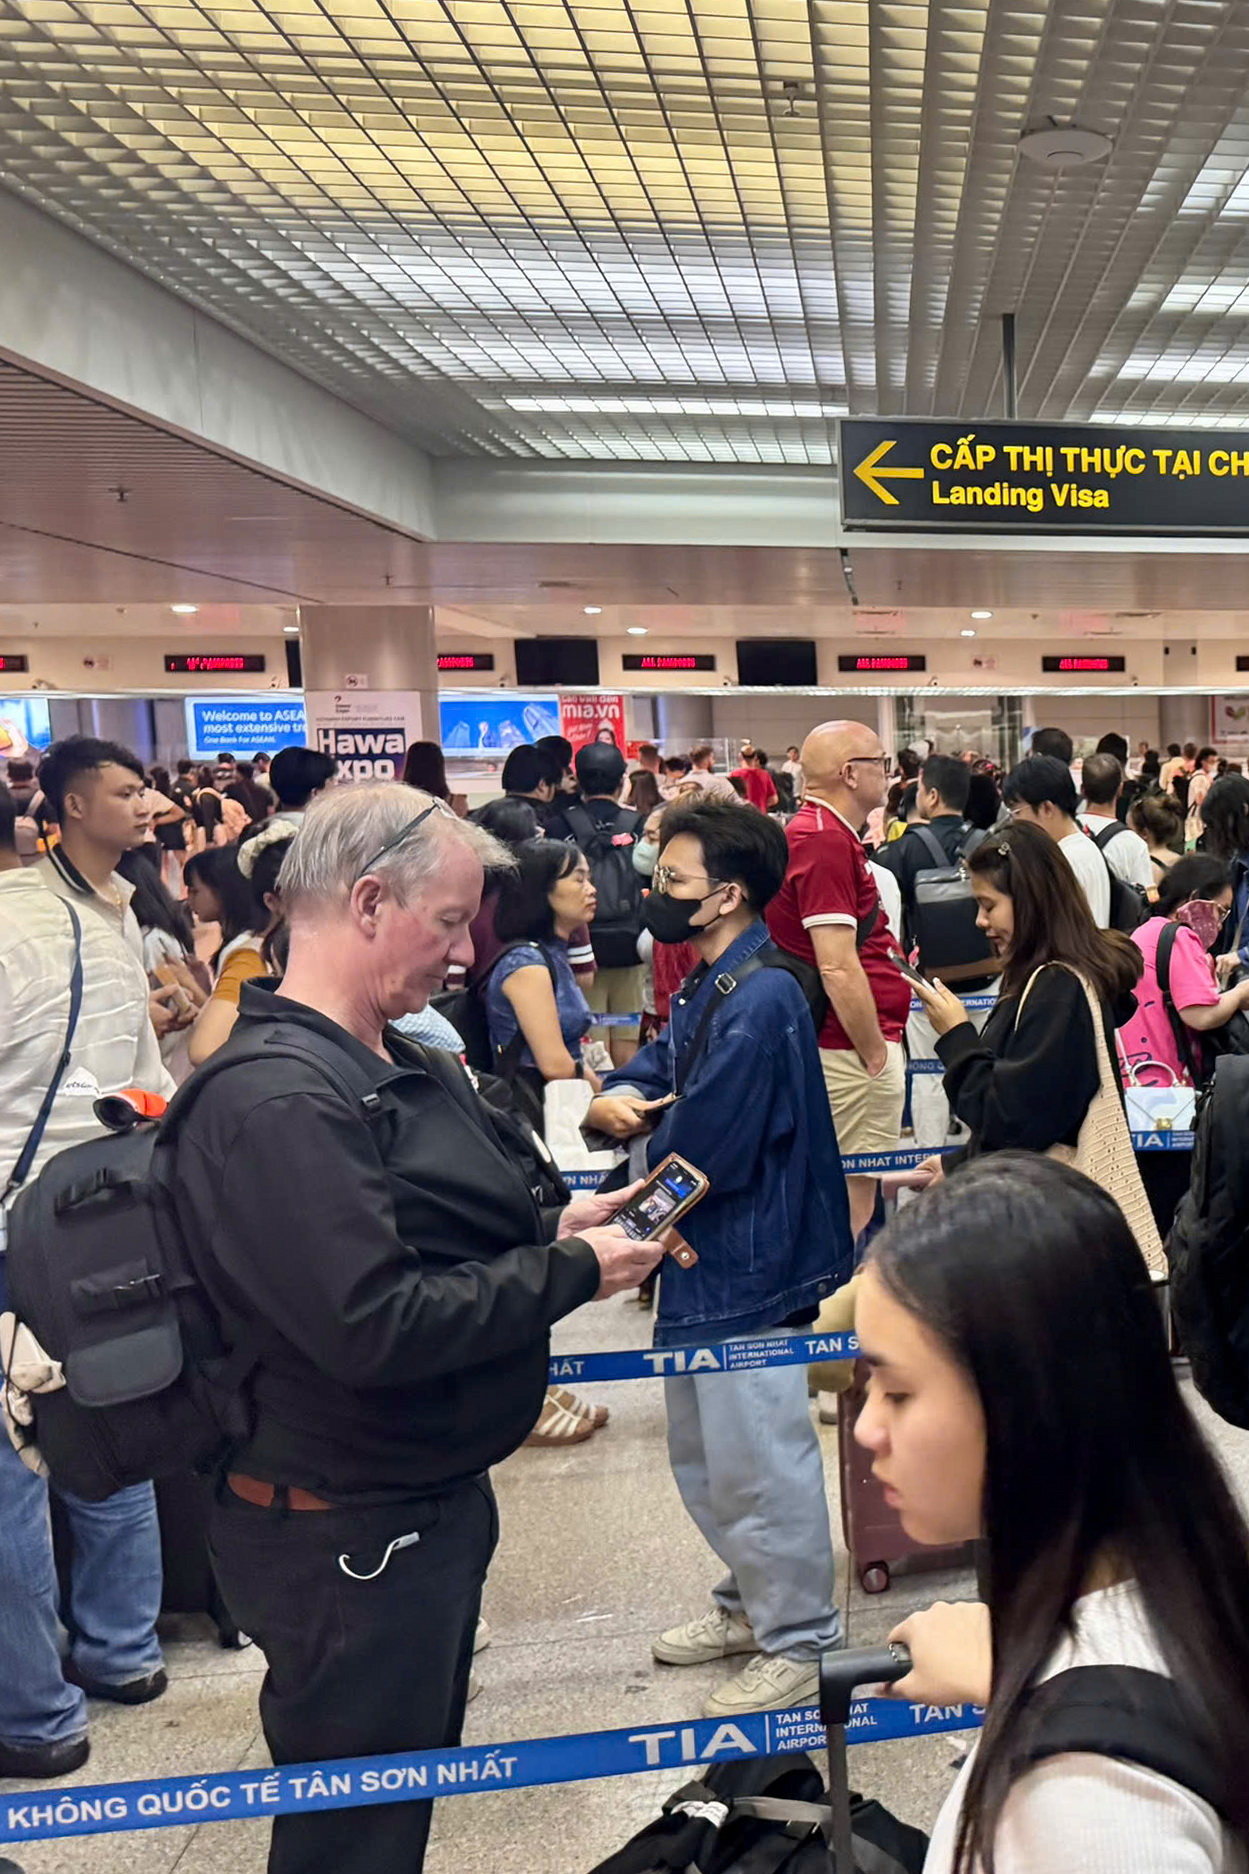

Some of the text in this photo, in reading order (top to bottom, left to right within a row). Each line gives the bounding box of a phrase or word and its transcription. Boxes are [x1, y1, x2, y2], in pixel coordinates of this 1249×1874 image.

[930, 434, 996, 471] CẤP
[1003, 445, 1053, 478] THỊ
[1060, 444, 1146, 478] THỰC
[1153, 449, 1201, 480] TẠI
[932, 480, 1110, 512] Landing Visa
[202, 710, 257, 722] Welcome
[259, 711, 273, 721] to
[562, 704, 620, 719] mia.vn
[203, 722, 234, 734] most
[235, 722, 291, 733] extensive
[318, 729, 405, 755] Hawa
[333, 757, 396, 783] xpo
[728, 1348, 794, 1360] INTERNATIONAL
[805, 1337, 842, 1355] TAN
[643, 1348, 720, 1374] TIA
[730, 1359, 767, 1369] AIRPORT
[775, 1711, 801, 1725] TAN
[804, 1709, 821, 1720] SO
[909, 1703, 963, 1724] TAN
[628, 1723, 758, 1766] TIA
[777, 1735, 827, 1751] AIRPOR
[8, 1749, 519, 1830] KHÔNG QUỐC TẾ TÂN SƠN NHẤT
